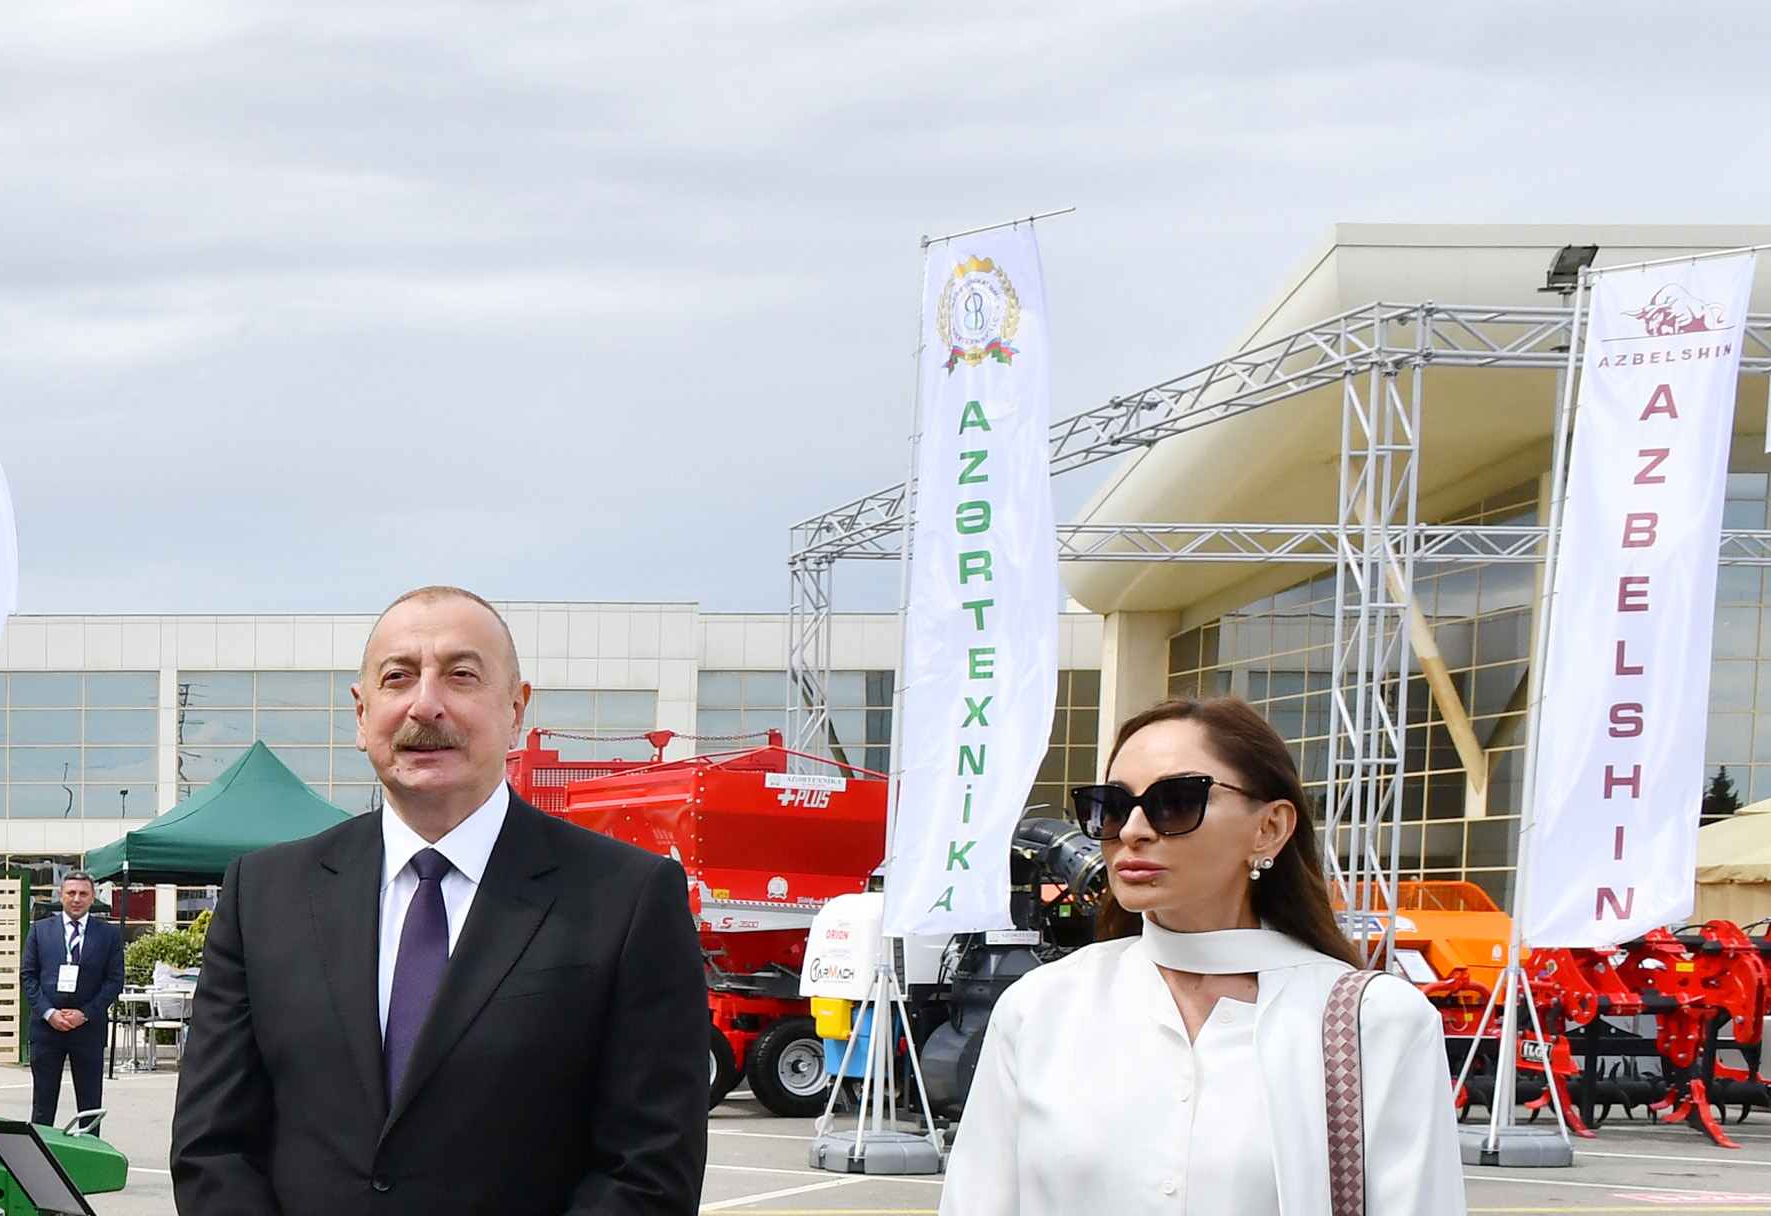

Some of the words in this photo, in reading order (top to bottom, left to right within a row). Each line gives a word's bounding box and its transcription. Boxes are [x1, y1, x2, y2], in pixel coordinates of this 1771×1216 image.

[1598, 343, 1732, 368] AZBELSHIN
[928, 400, 995, 914] AZƏRTEXNİKA
[1595, 384, 1679, 921] AZBELSHIN
[825, 929, 849, 940] ORION
